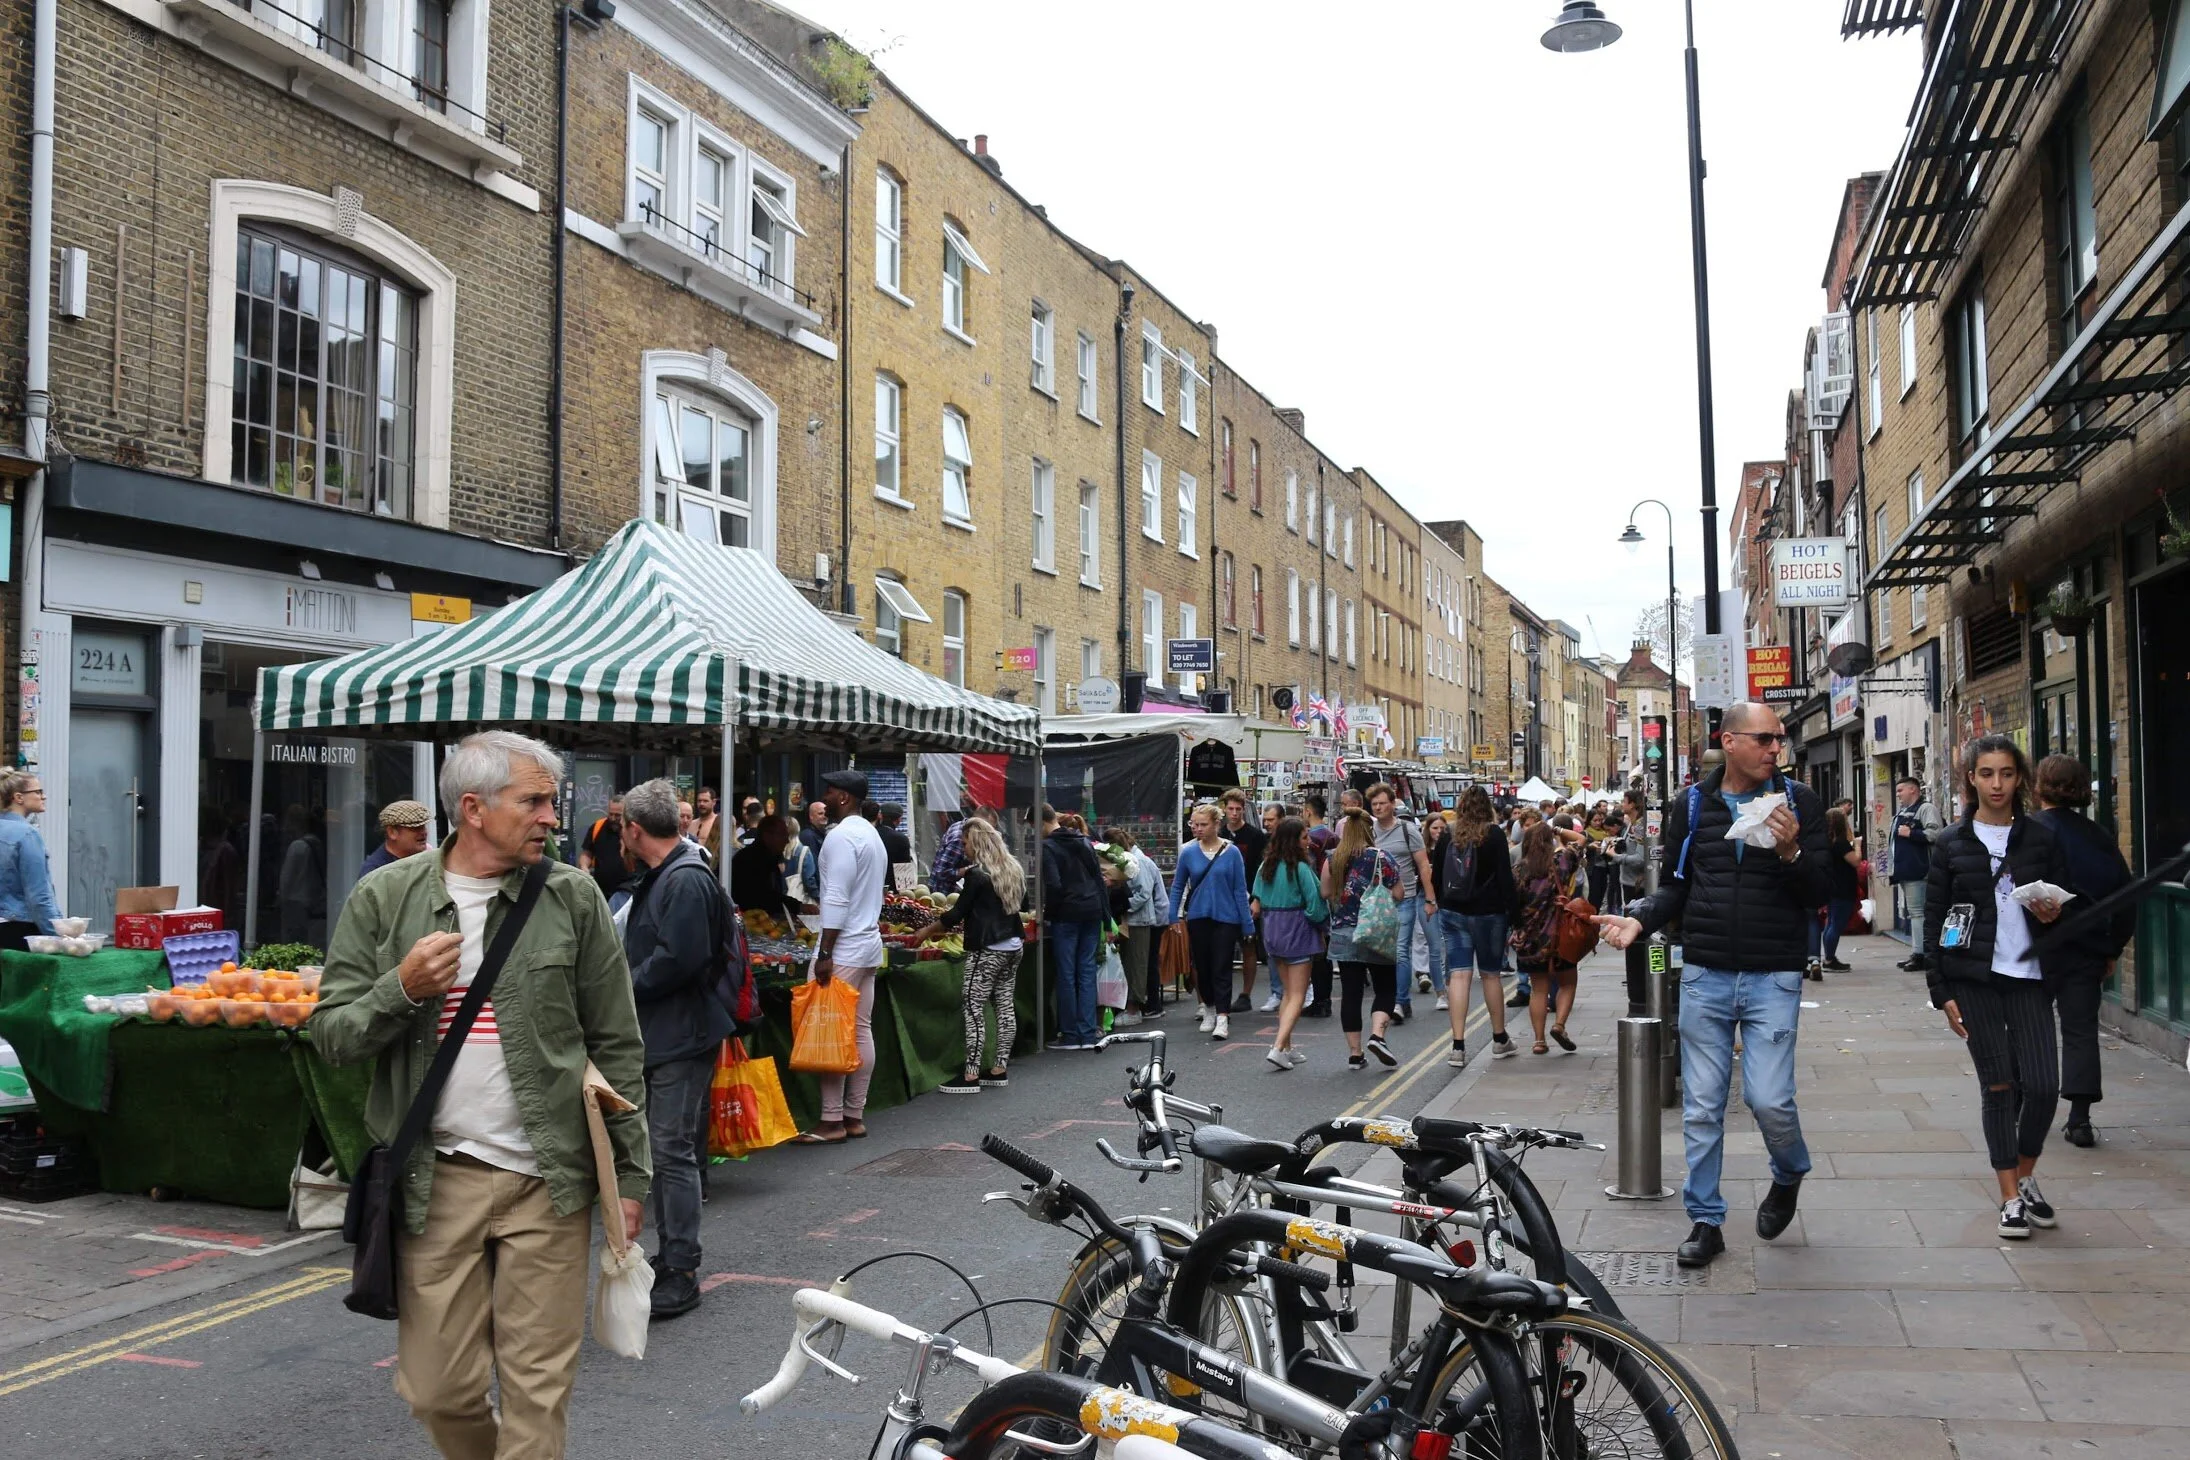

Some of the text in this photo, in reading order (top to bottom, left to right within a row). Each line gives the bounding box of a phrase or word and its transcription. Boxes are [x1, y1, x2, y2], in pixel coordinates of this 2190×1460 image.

[1792, 545, 1828, 557] HOT
[1780, 562, 1842, 580] BEIGELS
[1781, 585, 1842, 598] ALL NIGHT
[80, 648, 132, 673] 224 A
[1009, 655, 1031, 664] 220
[1755, 648, 1781, 661] HOT
[1755, 675, 1785, 687] SHOP
[1765, 688, 1807, 699] CROSSTOWN
[271, 744, 356, 764] ITALIAN BISTRO
[189, 922, 214, 933] APOLLO
[1196, 1361, 1234, 1387] Mustang
[1324, 1412, 1350, 1432] RALE
